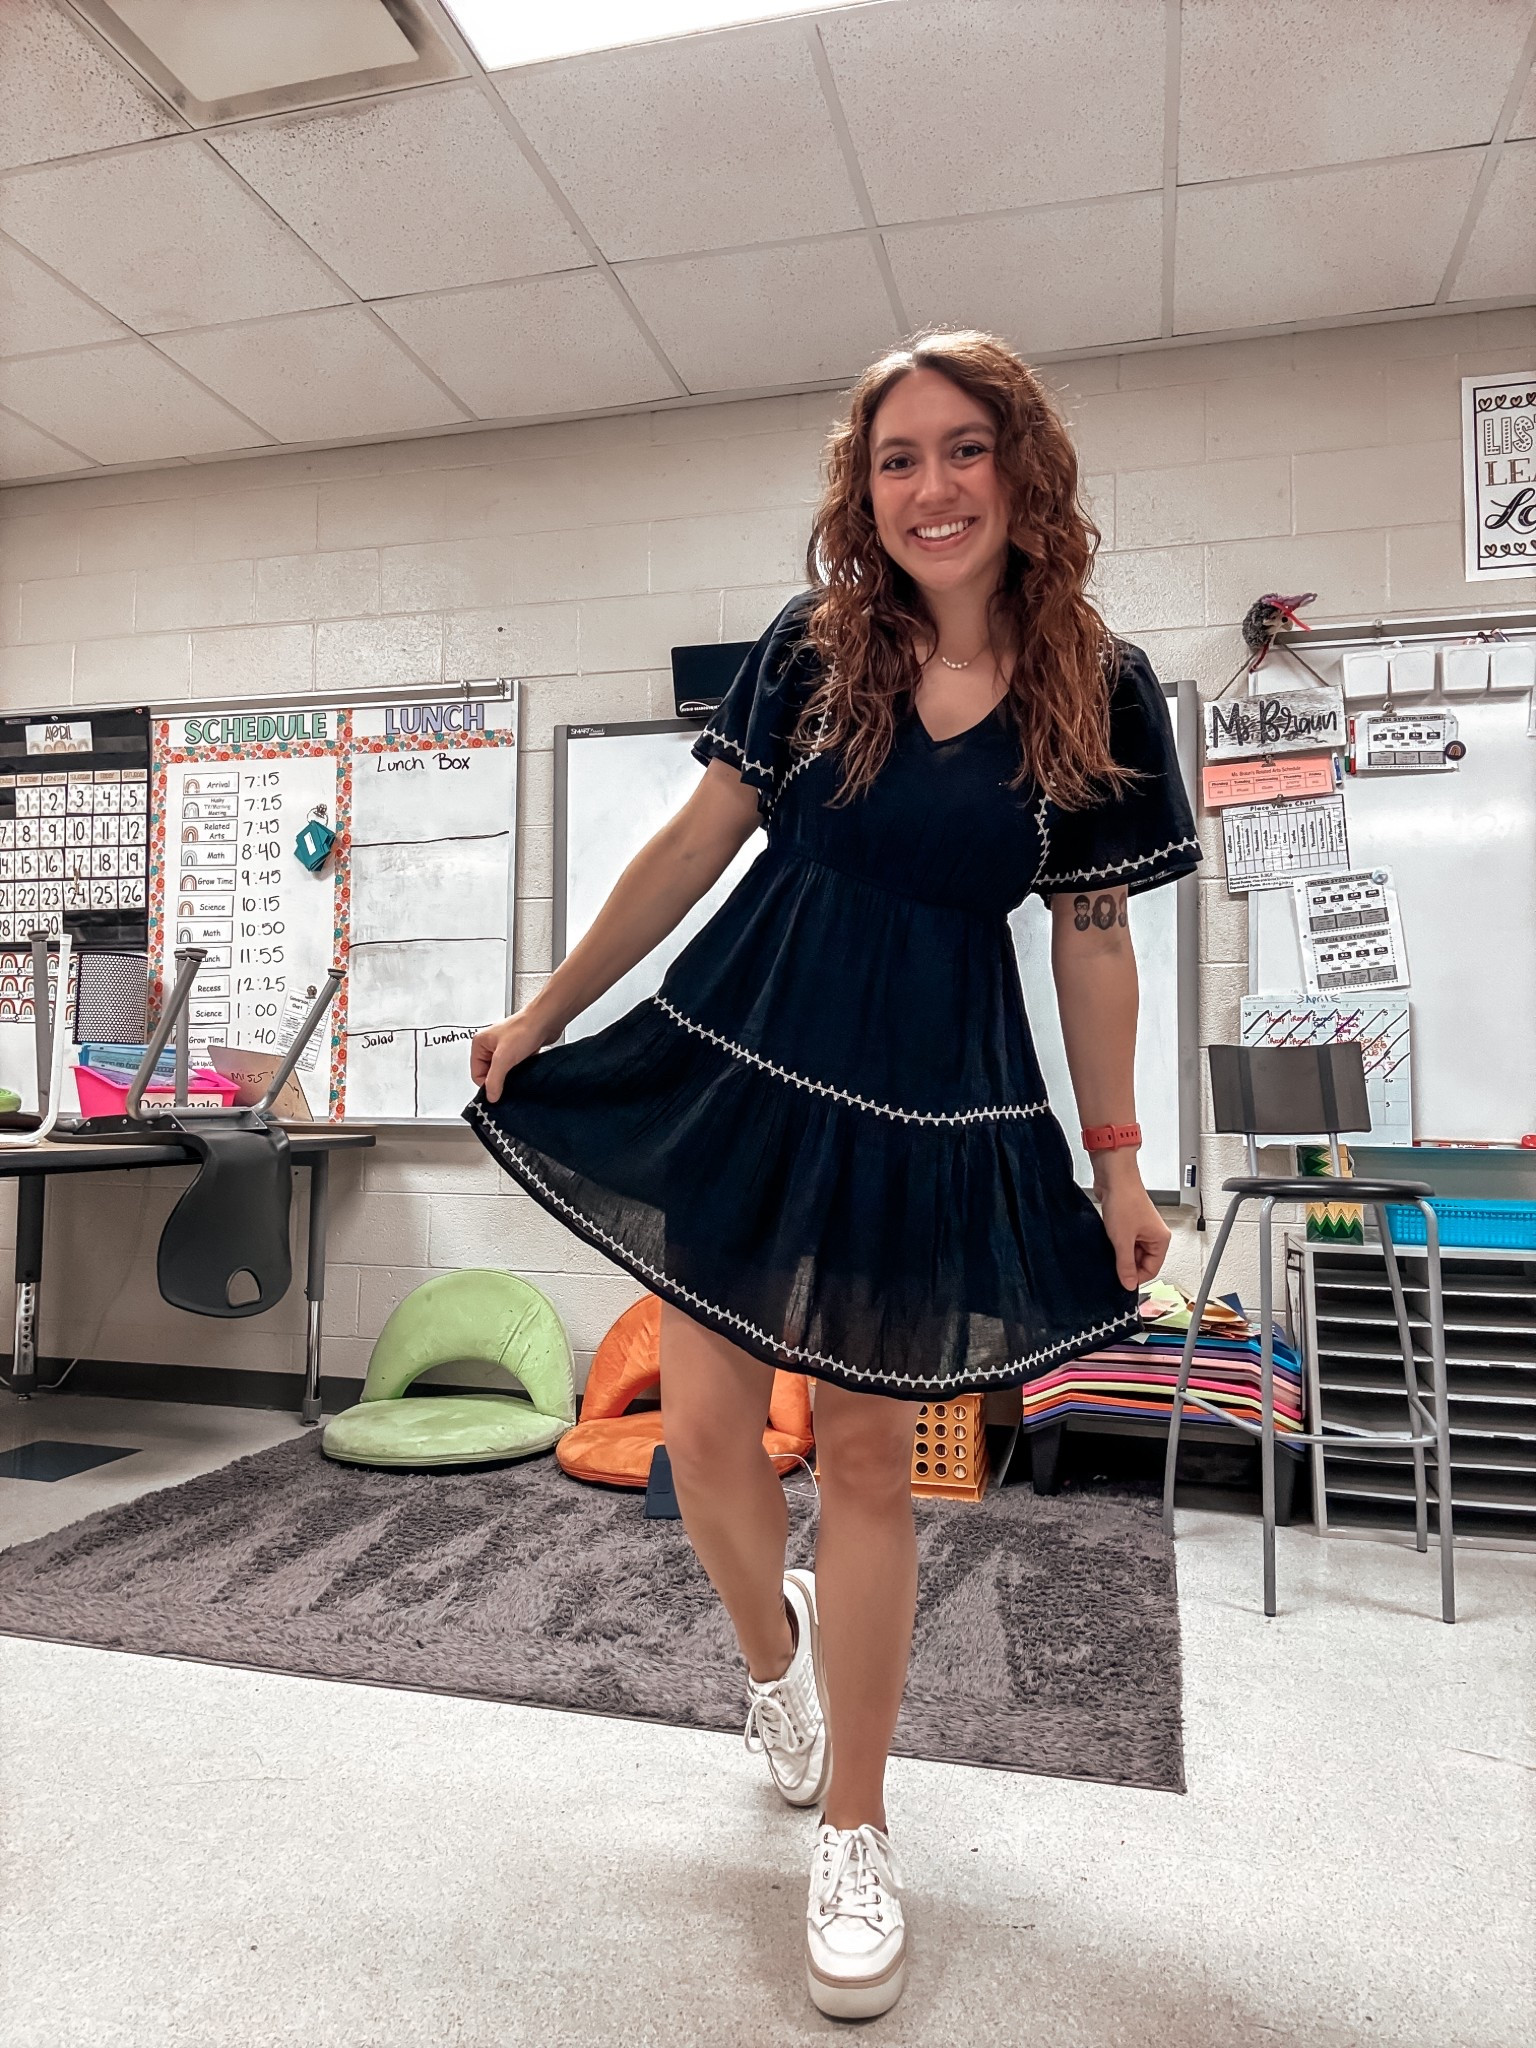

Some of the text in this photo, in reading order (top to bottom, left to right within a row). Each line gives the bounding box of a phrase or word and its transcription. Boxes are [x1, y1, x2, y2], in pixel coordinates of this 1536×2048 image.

[1483, 414, 1536, 456] LIS
[1485, 458, 1536, 486] LE
[184, 713, 328, 744] SCHEDULE
[385, 704, 485, 735] LUNCH
[377, 752, 471, 772] Lunch Box
[206, 781, 230, 789] Arrival
[245, 772, 280, 788] 7:15
[49, 793, 58, 810] 2
[77, 791, 84, 808] 3
[103, 791, 111, 807] 4
[130, 790, 138, 807] 5
[244, 794, 282, 811] 7:25
[1295, 799, 1316, 807] Chart
[23, 825, 31, 842] 8
[49, 824, 56, 841] 9
[73, 822, 84, 841] 10
[102, 822, 109, 840] 11
[127, 821, 139, 840] 12
[204, 823, 230, 831] Related
[243, 819, 280, 837] 7:45
[241, 841, 281, 861] 8:40
[21, 856, 32, 874] 15
[45, 855, 57, 873] 16
[73, 854, 84, 872] 17
[100, 853, 111, 871] 18
[127, 853, 138, 871] 19
[198, 877, 233, 886] Grow Time
[241, 870, 281, 886] 9:45
[18, 888, 35, 906] 22
[43, 888, 59, 905] 23
[95, 886, 112, 904] 25
[122, 885, 141, 903] 26
[242, 896, 280, 912] 10:15
[241, 921, 285, 937] 10:50
[240, 946, 284, 964] 11:55
[197, 984, 221, 992] Recess
[237, 976, 286, 995] 12:25
[1306, 995, 1329, 1004] April
[195, 1010, 222, 1018] Science
[189, 1036, 224, 1044] Grow Time
[237, 1028, 276, 1046] 1:40
[362, 1028, 478, 1048] Salad Lunchab
[139, 1099, 219, 1108] Decials
